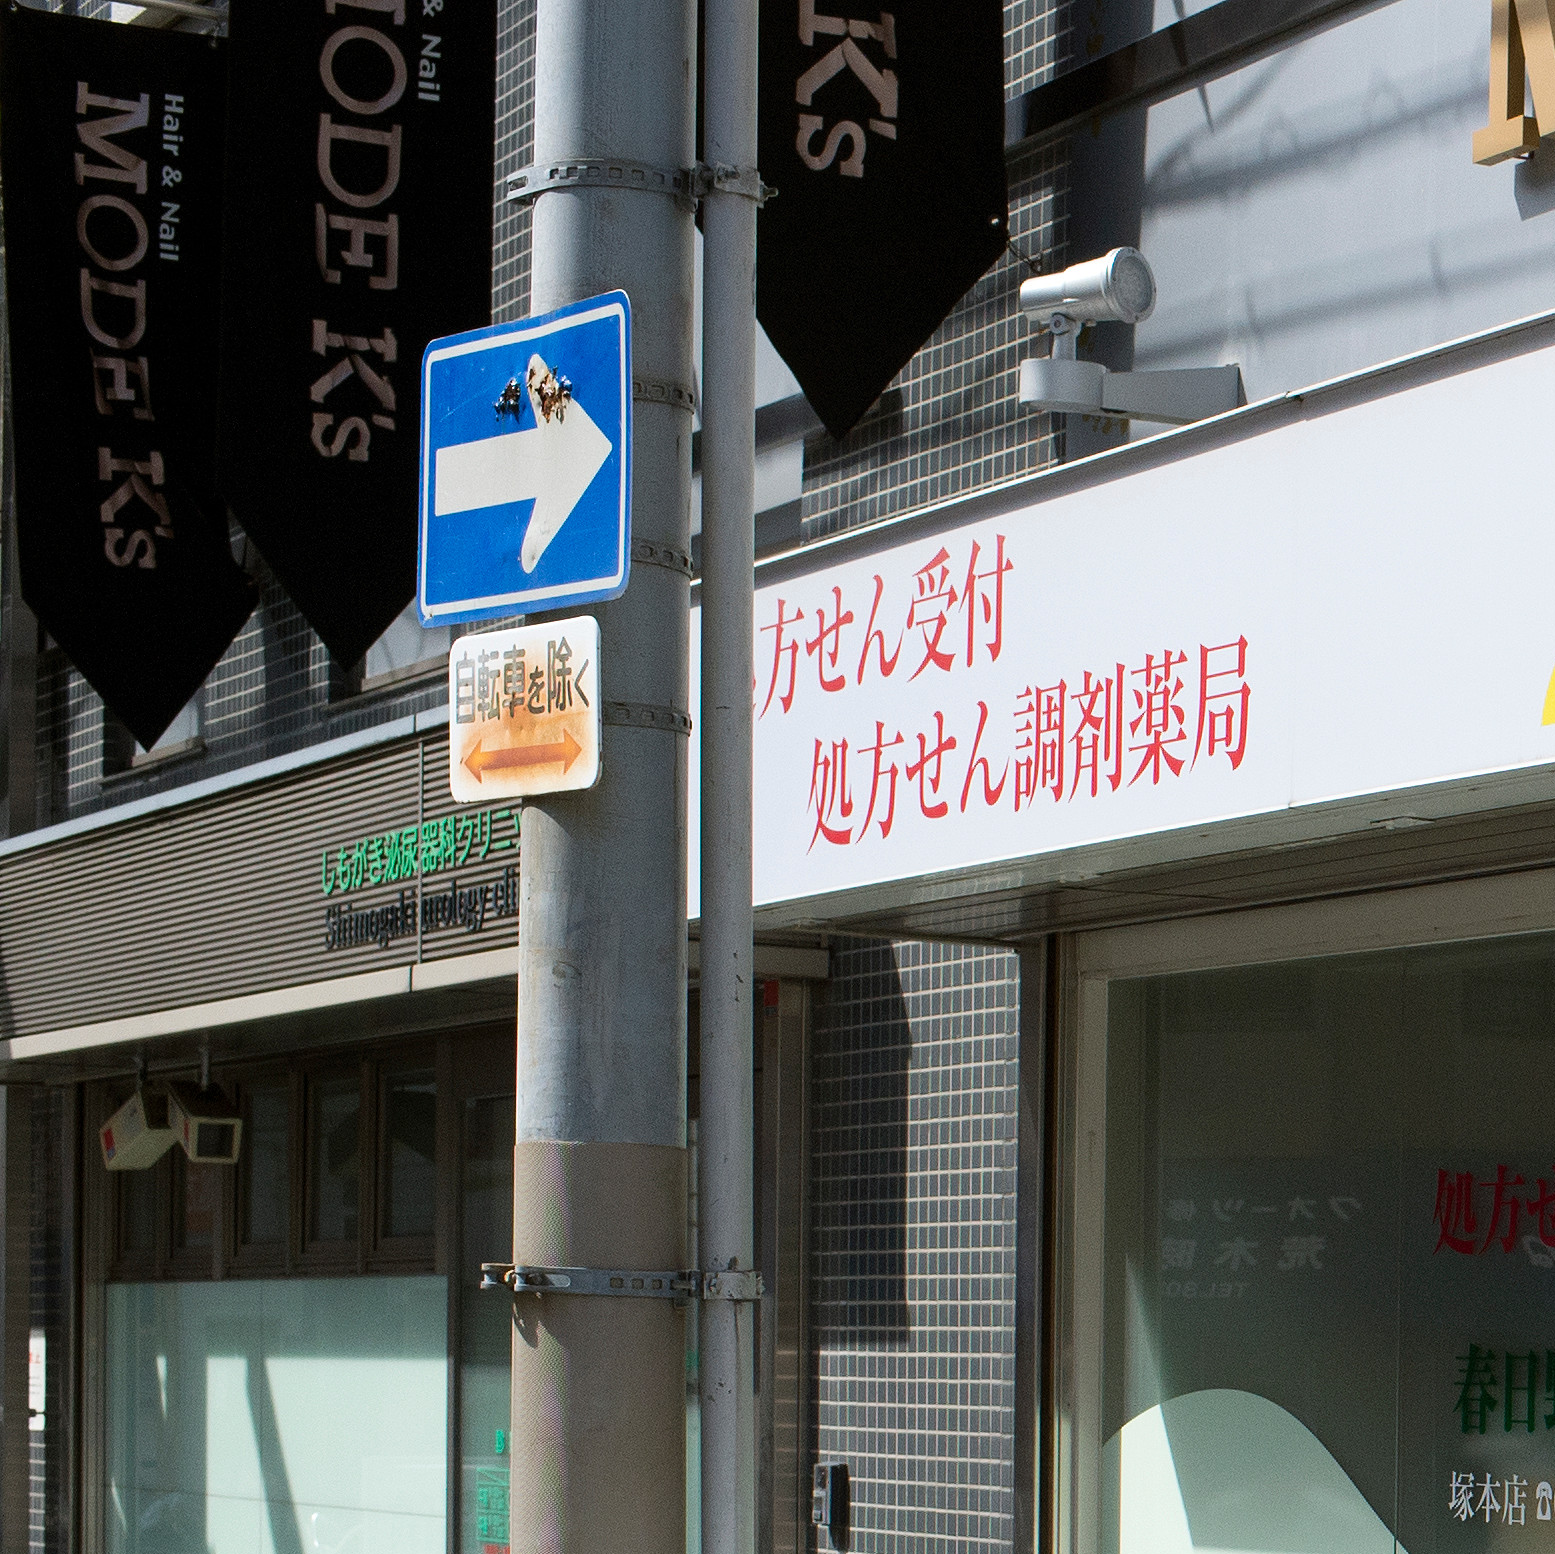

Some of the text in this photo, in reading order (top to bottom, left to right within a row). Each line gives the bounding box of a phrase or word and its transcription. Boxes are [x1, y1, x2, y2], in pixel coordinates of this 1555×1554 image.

[314, 0, 408, 291] ODE
[417, 33, 441, 102] Nail
[75, 81, 152, 421] MODE
[159, 93, 185, 261] Hair & Nail
[456, 636, 590, 727] 自転車を除く
[754, 534, 1014, 722] 方せん受付
[805, 633, 1251, 856] 処方せん調剤薬局
[325, 866, 520, 951] Shimogaki urology cli
[1447, 1469, 1528, 1528] 塚本店
